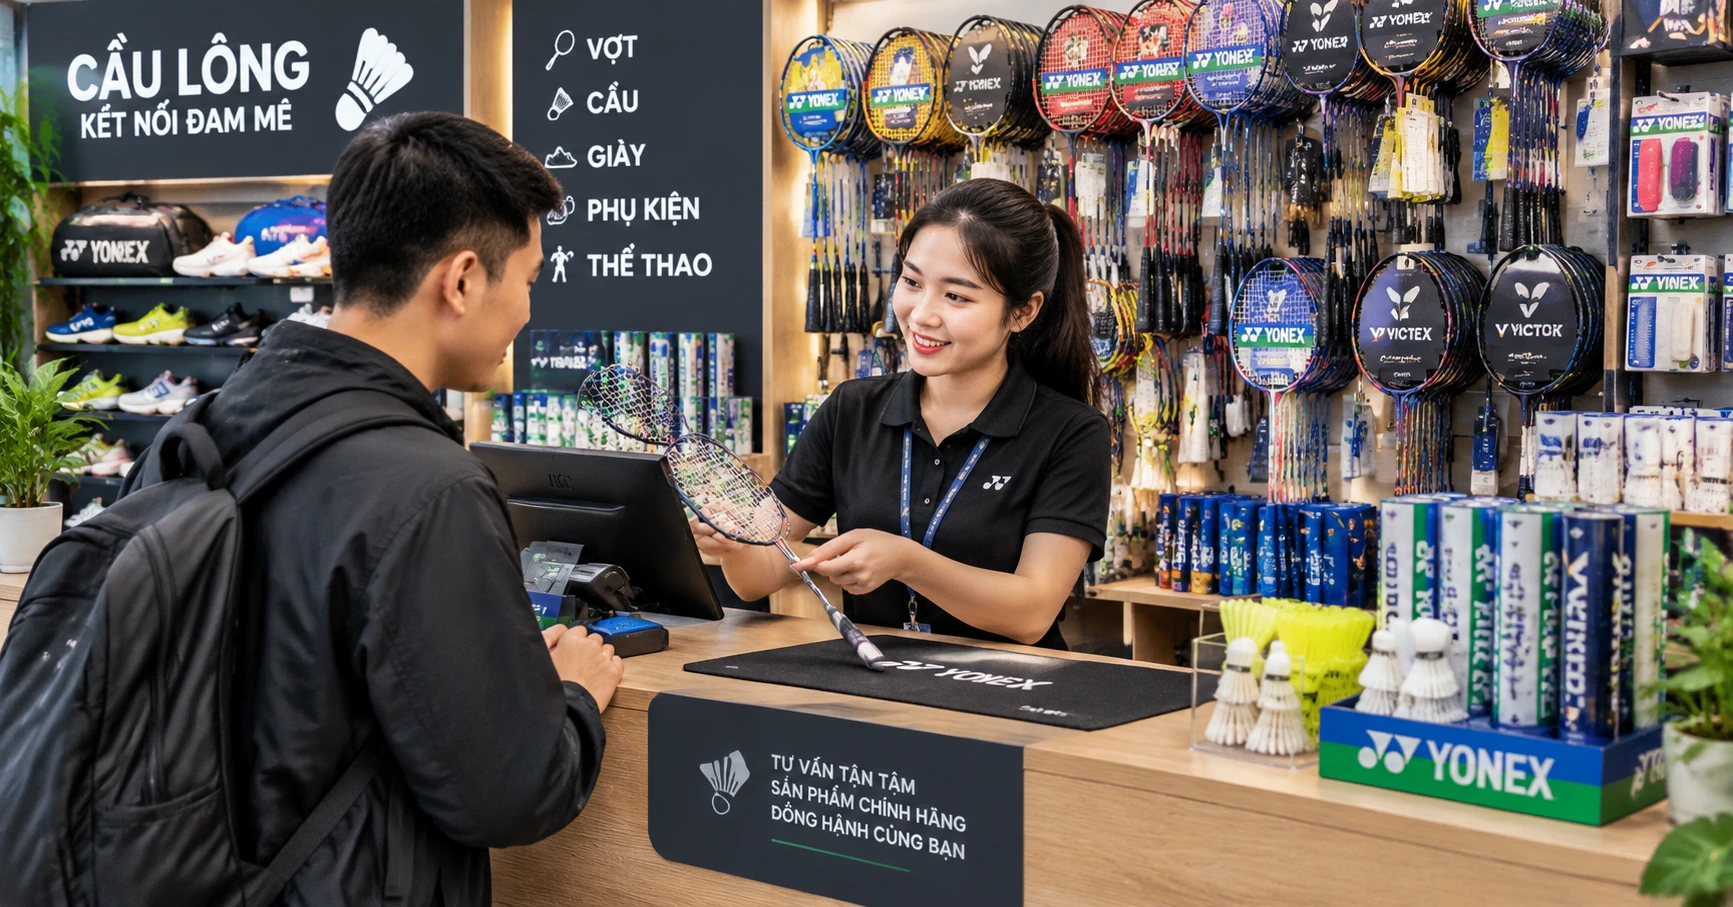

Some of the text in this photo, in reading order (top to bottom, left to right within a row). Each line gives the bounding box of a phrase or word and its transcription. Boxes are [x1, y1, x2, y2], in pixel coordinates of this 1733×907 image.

[586, 33, 638, 65] VỢT
[67, 32, 310, 102] CẦU LÔNG
[81, 98, 293, 139] KẾT NỐI ĐAM MÊ
[587, 139, 646, 168] GIÀY
[587, 190, 700, 227] PHỤ KIỆN
[587, 243, 713, 277] THỂ THAO
[1264, 327, 1306, 344] YONEX
[771, 753, 795, 772] TƯ
[838, 763, 873, 788] TẬN
[1425, 739, 1555, 801] YONEX
[858, 797, 911, 821] CHÍNH
[928, 837, 965, 861] BẠN
